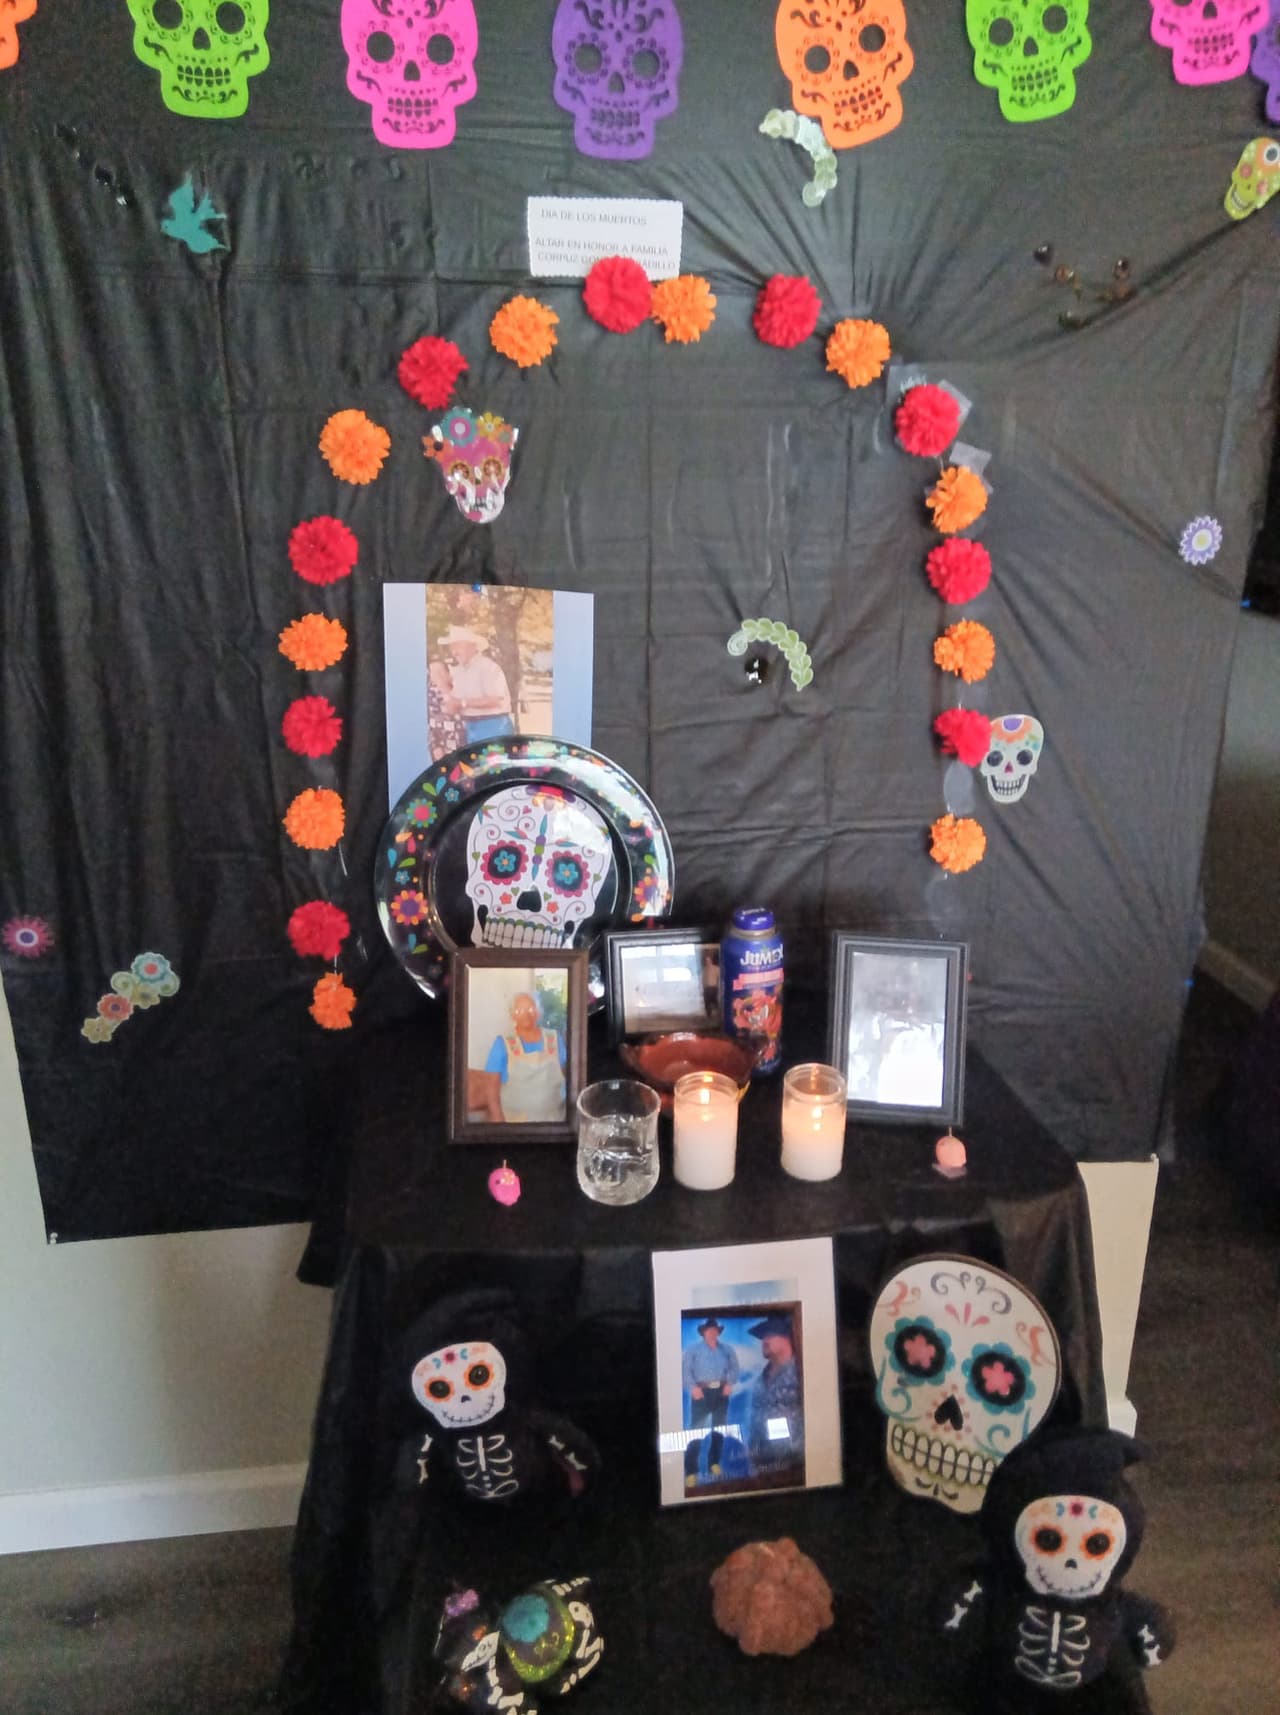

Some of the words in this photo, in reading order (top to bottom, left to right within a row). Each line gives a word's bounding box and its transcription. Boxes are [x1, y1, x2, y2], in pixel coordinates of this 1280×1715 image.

[541, 208, 558, 219] DIA
[560, 209, 574, 221] DE
[576, 211, 597, 222] LOS
[599, 213, 647, 226] MUERTOS
[535, 237, 565, 249] ALTAR
[567, 239, 581, 250] EN
[583, 241, 618, 253] HONOR
[631, 244, 669, 256] FAMILIA
